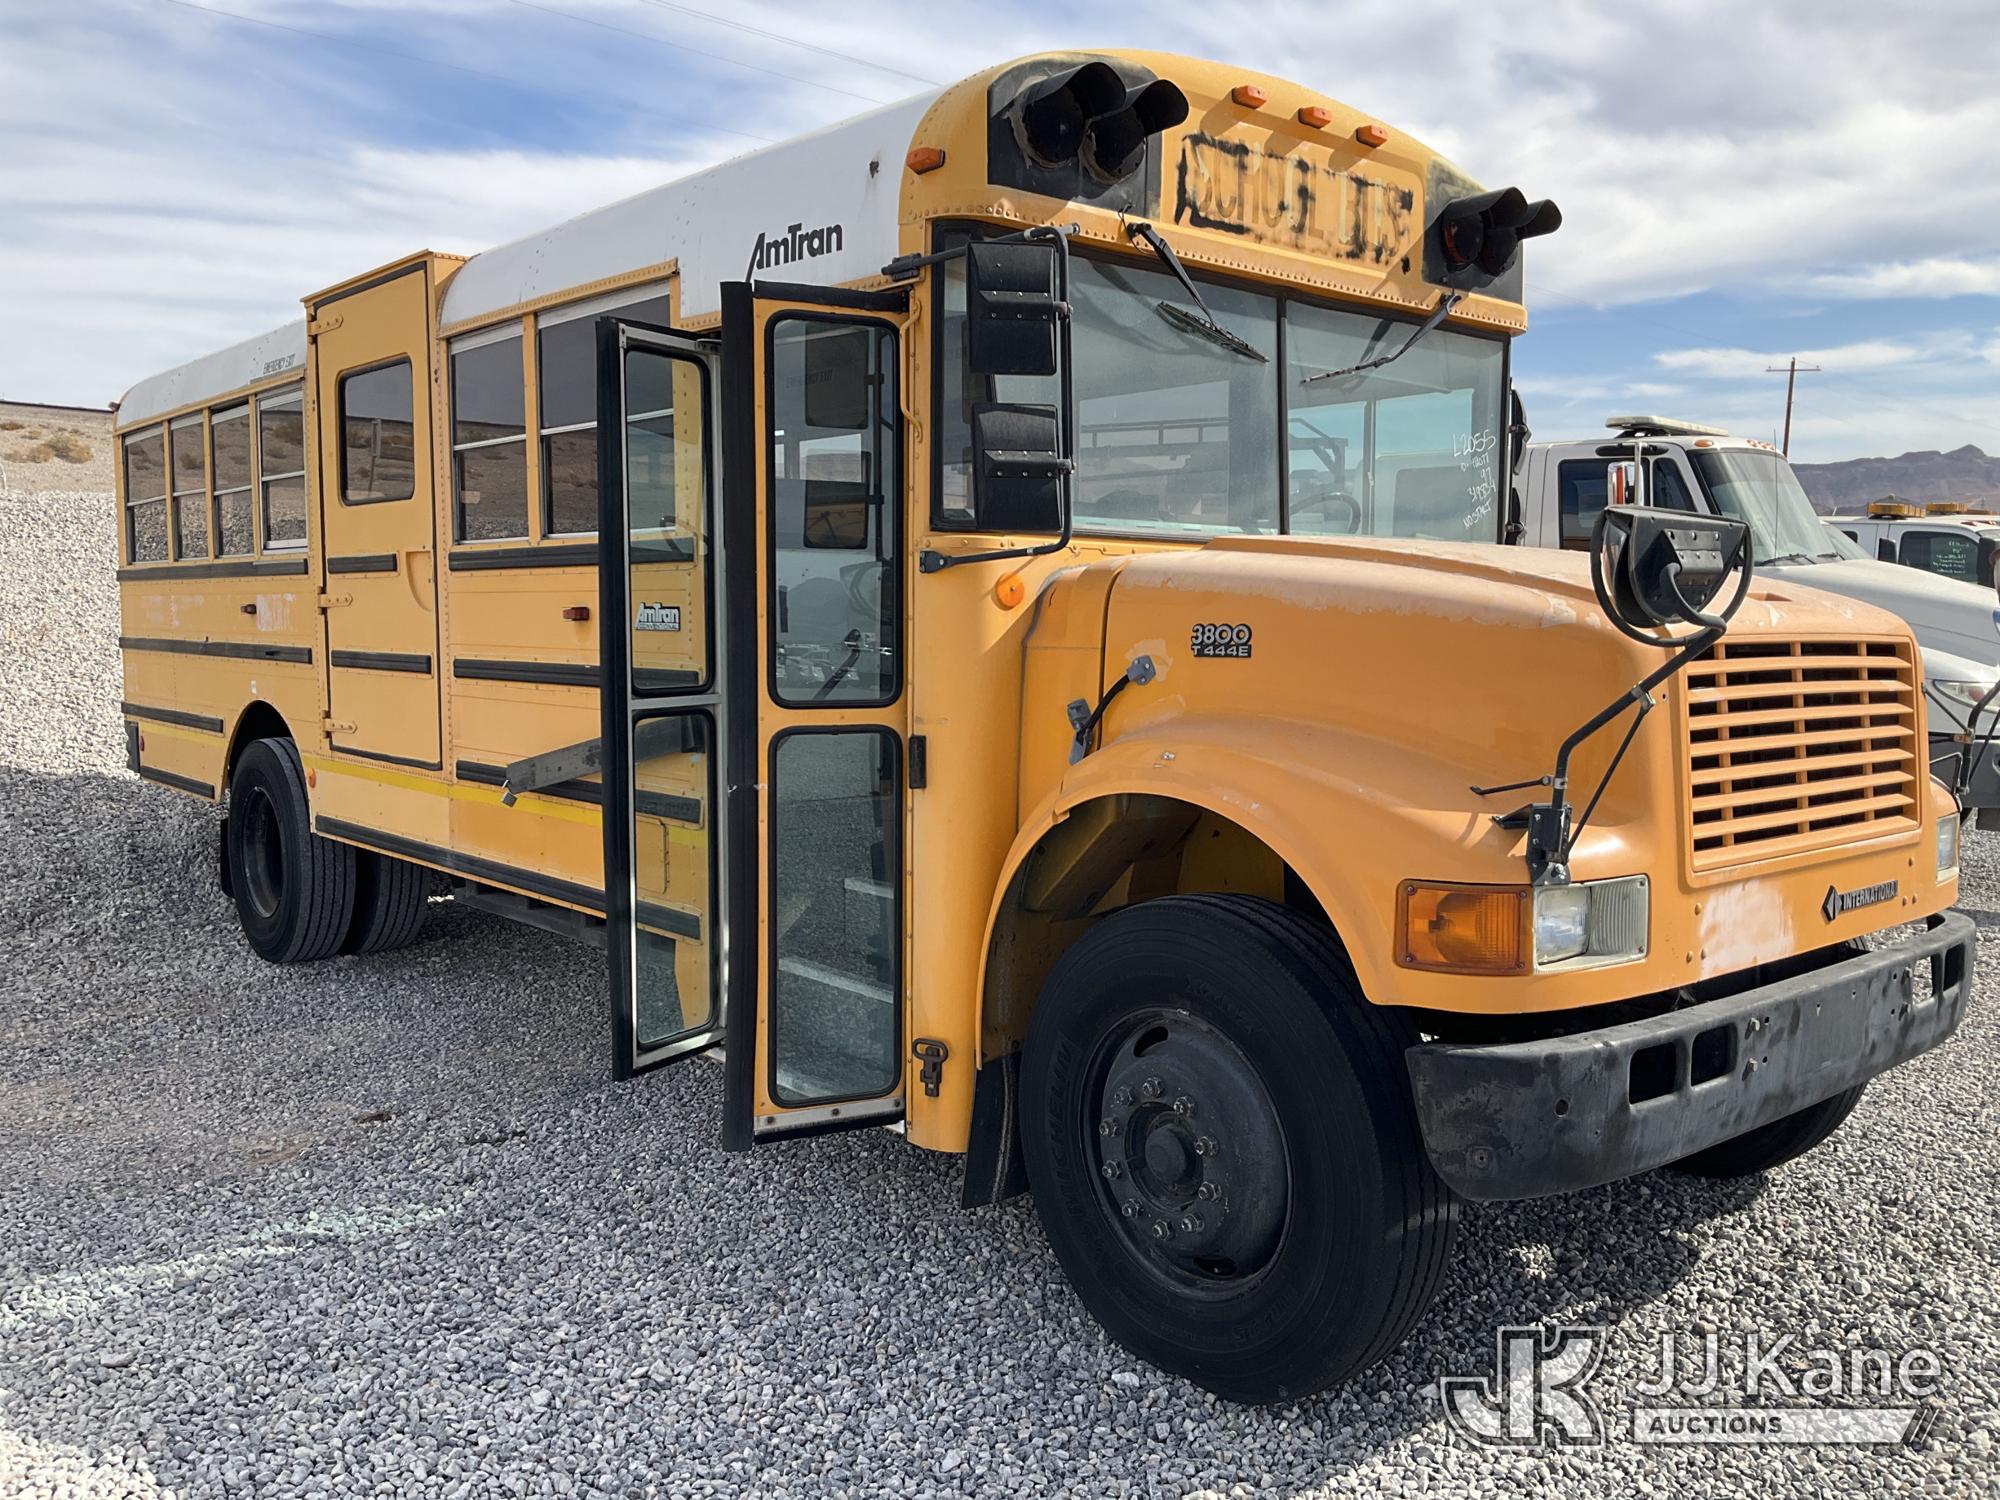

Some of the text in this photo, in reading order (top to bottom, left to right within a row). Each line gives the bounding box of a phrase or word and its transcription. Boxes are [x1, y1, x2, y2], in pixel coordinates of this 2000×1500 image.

[745, 223, 843, 282] AmTran
[635, 602, 680, 628] AmTran
[1191, 623, 1252, 645] 3800
[1191, 645, 1250, 657] T 444E
